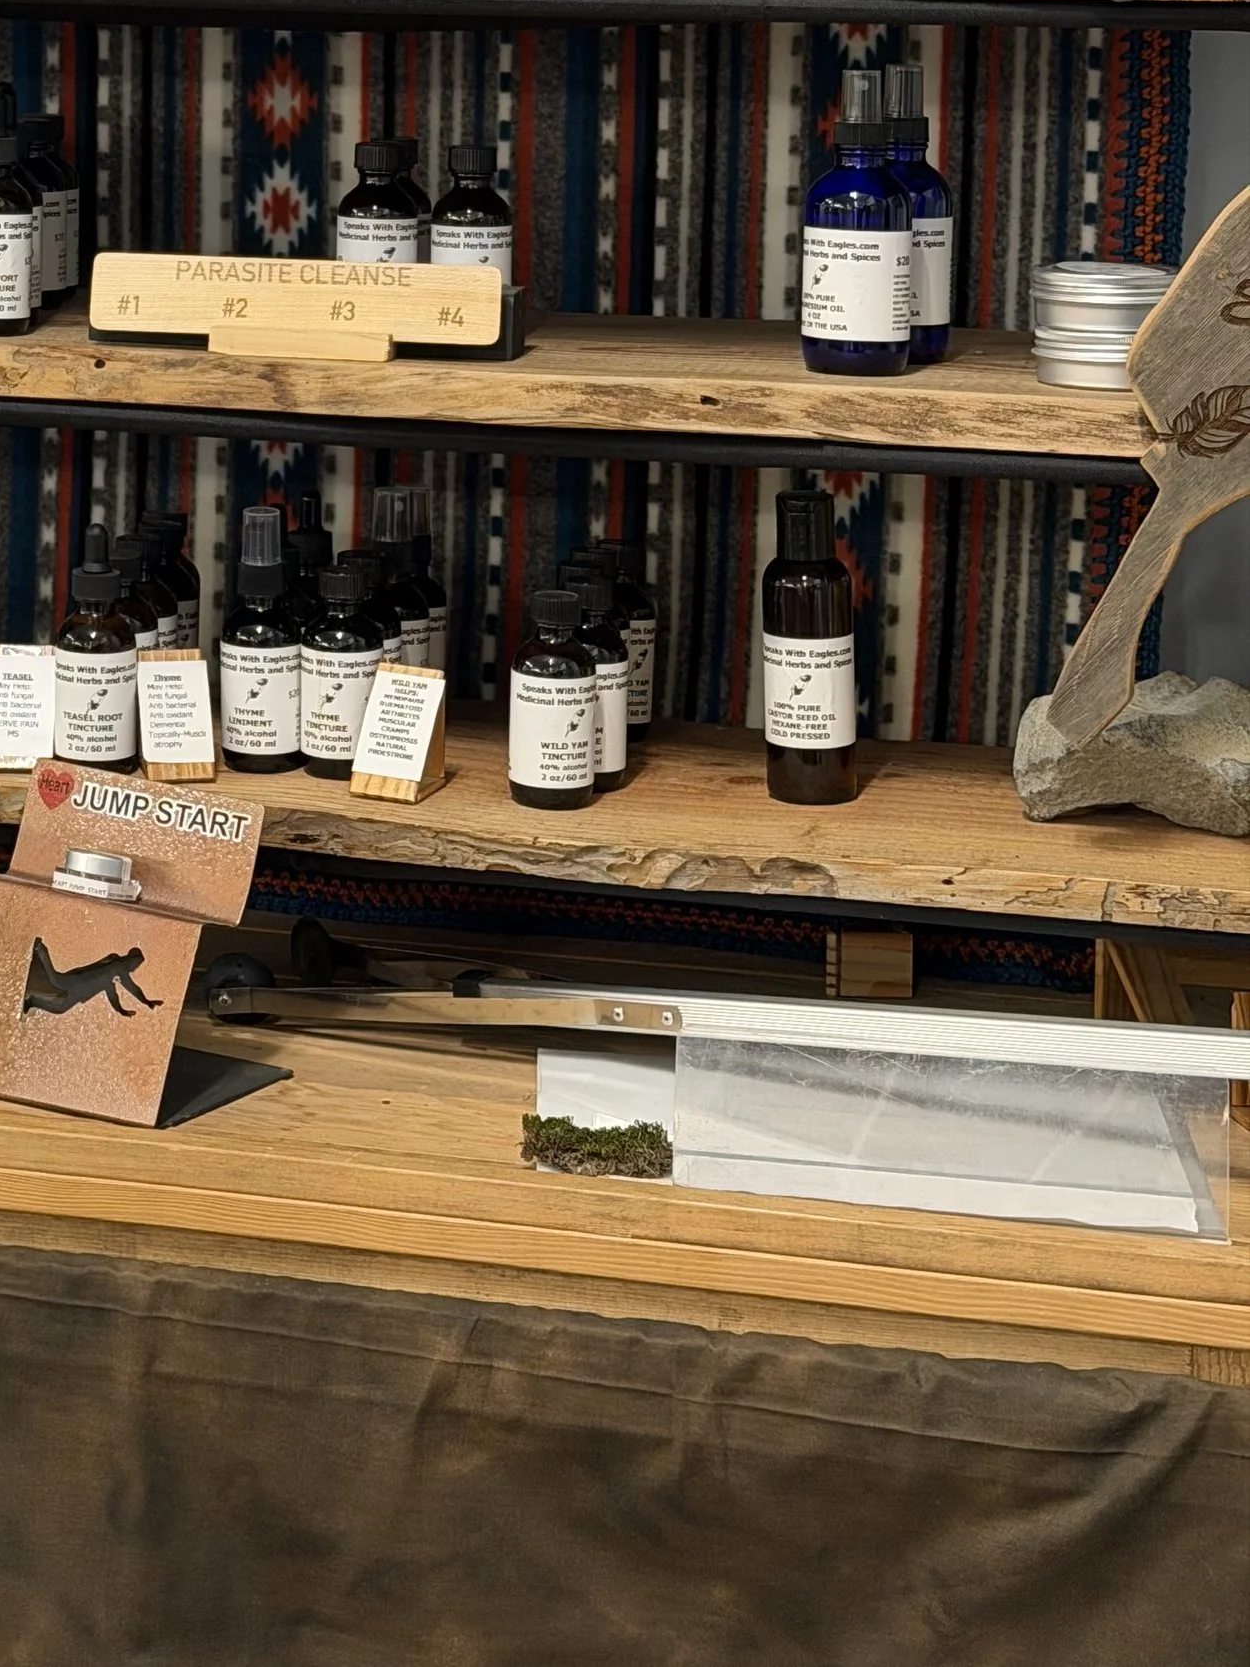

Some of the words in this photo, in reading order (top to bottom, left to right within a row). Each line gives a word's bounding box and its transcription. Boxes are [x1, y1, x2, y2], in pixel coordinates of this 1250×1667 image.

[344, 222, 370, 231] Speaks
[436, 230, 460, 239] Speaks
[896, 255, 909, 266] $20
[176, 261, 292, 284] PARASITE
[299, 264, 411, 287] CLEANSE
[816, 294, 835, 302] PURE
[117, 295, 141, 316] #1
[222, 298, 248, 319] #2
[330, 301, 356, 321] #3
[437, 307, 465, 327] #4
[830, 304, 845, 313] OIL
[830, 323, 847, 331] USA
[2, 673, 34, 681] TEASEL
[522, 683, 552, 695] Speaks
[384, 693, 425, 704] MENOPAUSE
[517, 694, 554, 705] Medicinal
[234, 708, 265, 717] THYME
[798, 704, 821, 712] PURE
[63, 711, 95, 721] TEASEL
[98, 713, 123, 721] ROOT
[311, 712, 340, 722] THYME
[380, 710, 420, 720] ARTHRITIS
[768, 709, 793, 720] CASTOR
[796, 713, 818, 721] SEED
[229, 718, 273, 727] LINIMENT
[378, 717, 416, 727] MUSCULAR
[771, 719, 827, 730] HEXANE-FREE
[790, 731, 830, 740] PRESSED
[375, 741, 407, 751] NATURAL
[540, 741, 568, 749] WILD
[571, 741, 588, 749] YAM
[40, 774, 70, 794] Heart
[73, 785, 149, 818] JUMP
[155, 801, 249, 840] START
